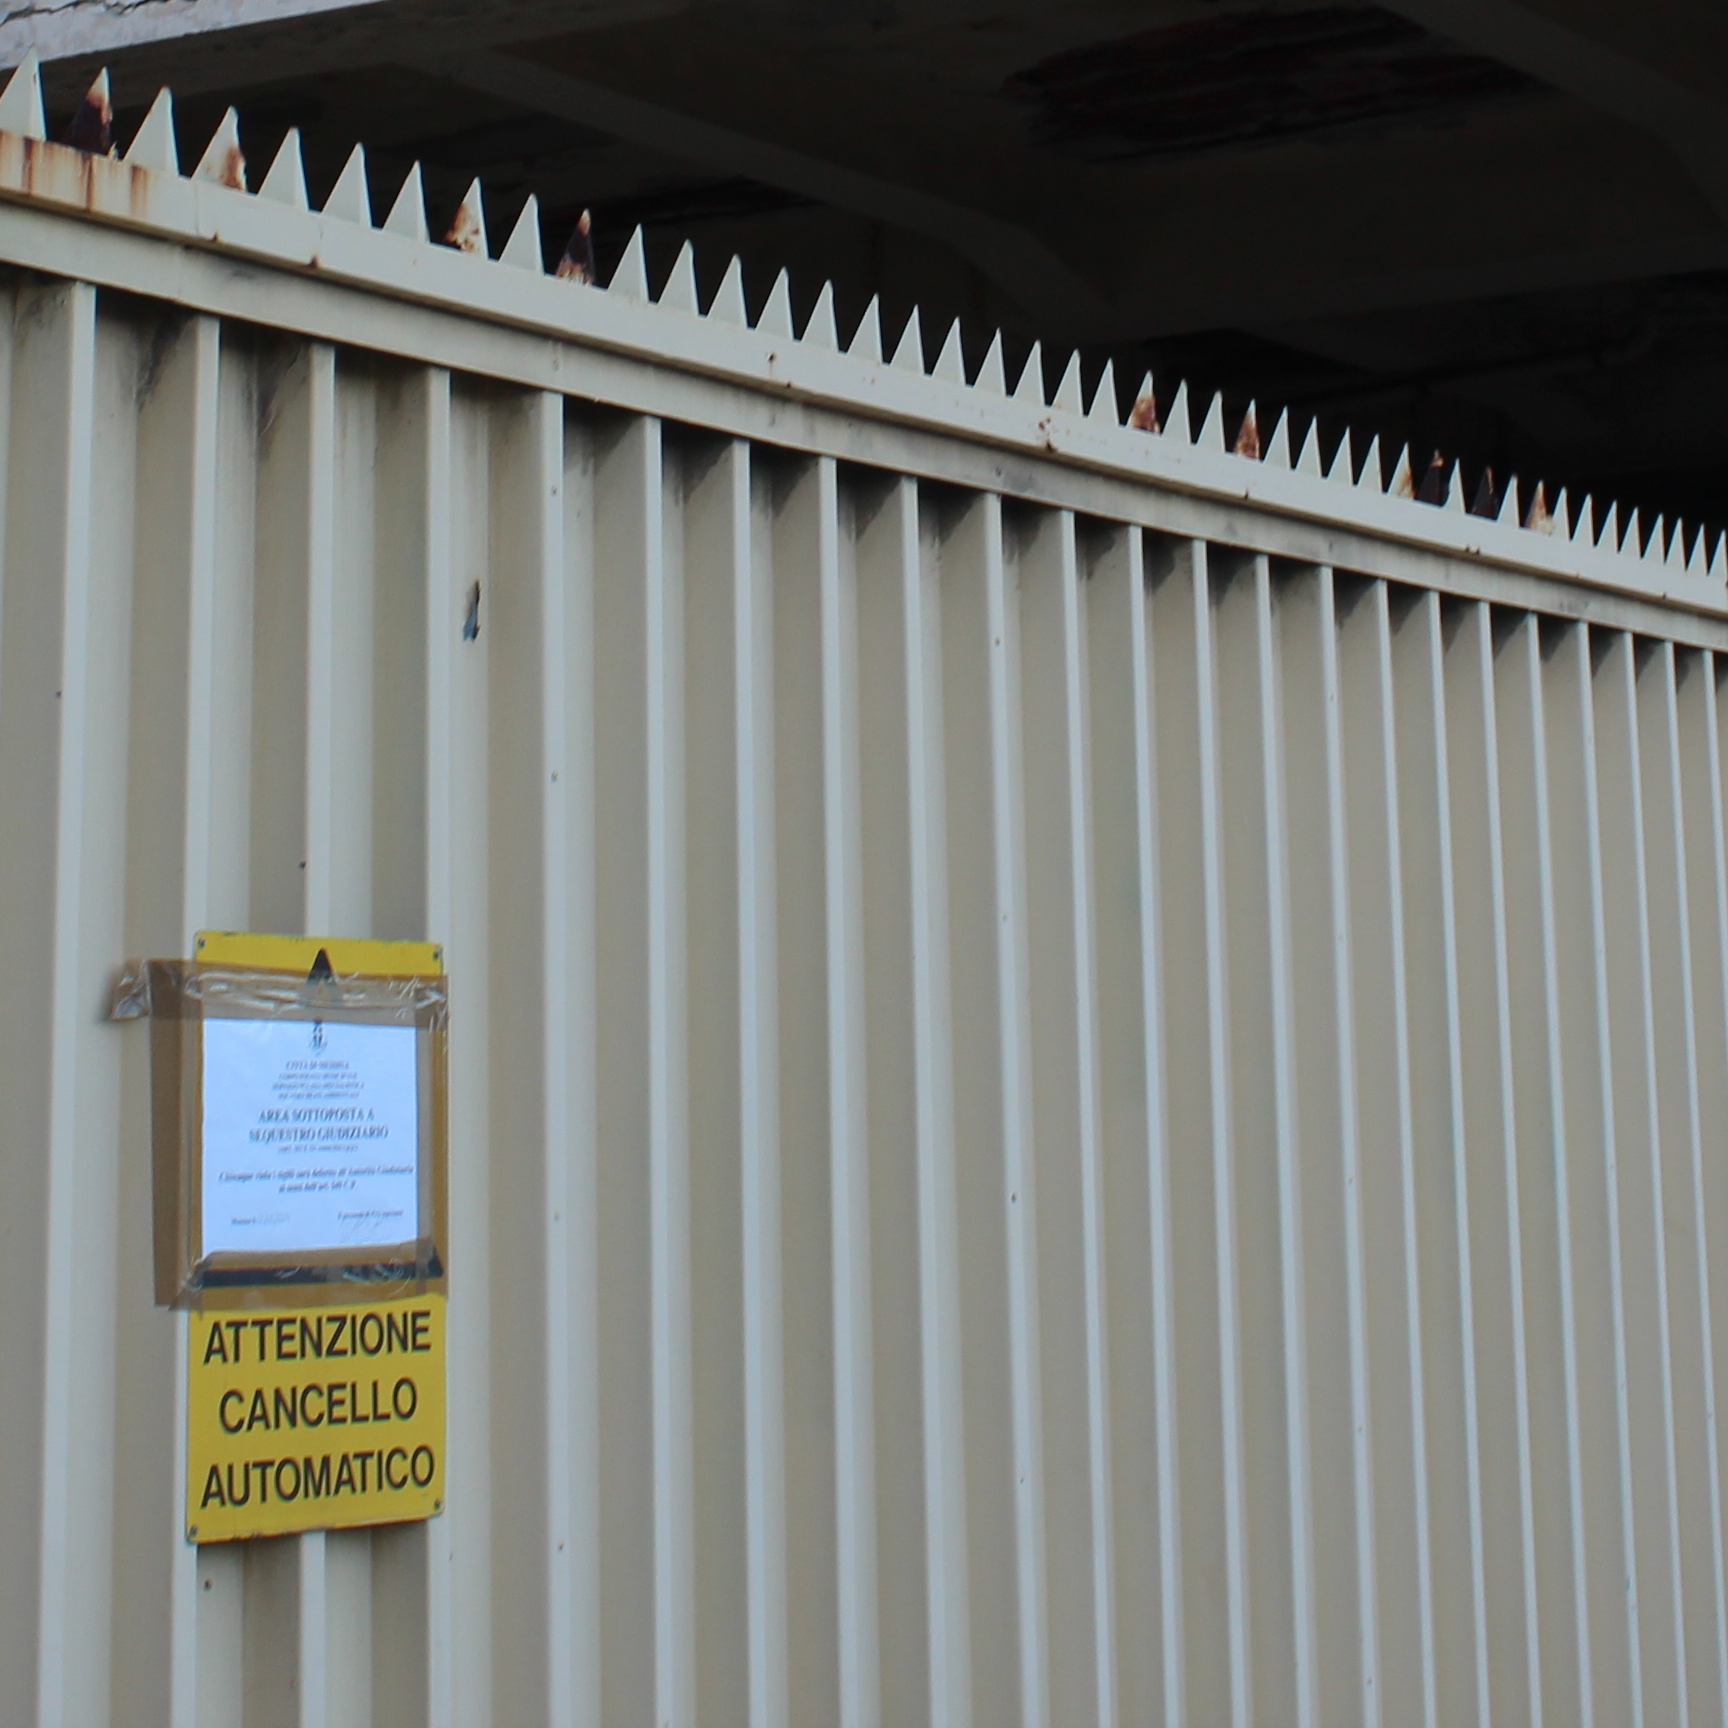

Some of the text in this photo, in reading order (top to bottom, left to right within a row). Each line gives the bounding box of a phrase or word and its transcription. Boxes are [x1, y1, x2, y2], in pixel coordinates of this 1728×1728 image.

[249, 1125, 389, 1144] SEQUESTRO GIUDIZIARIO
[259, 1107, 375, 1123] AREA SOTTOPOSTA A
[203, 1310, 431, 1365] ATTENZIONE
[219, 1377, 418, 1434] CANCELLO
[200, 1444, 435, 1509] AUTOMATICO
